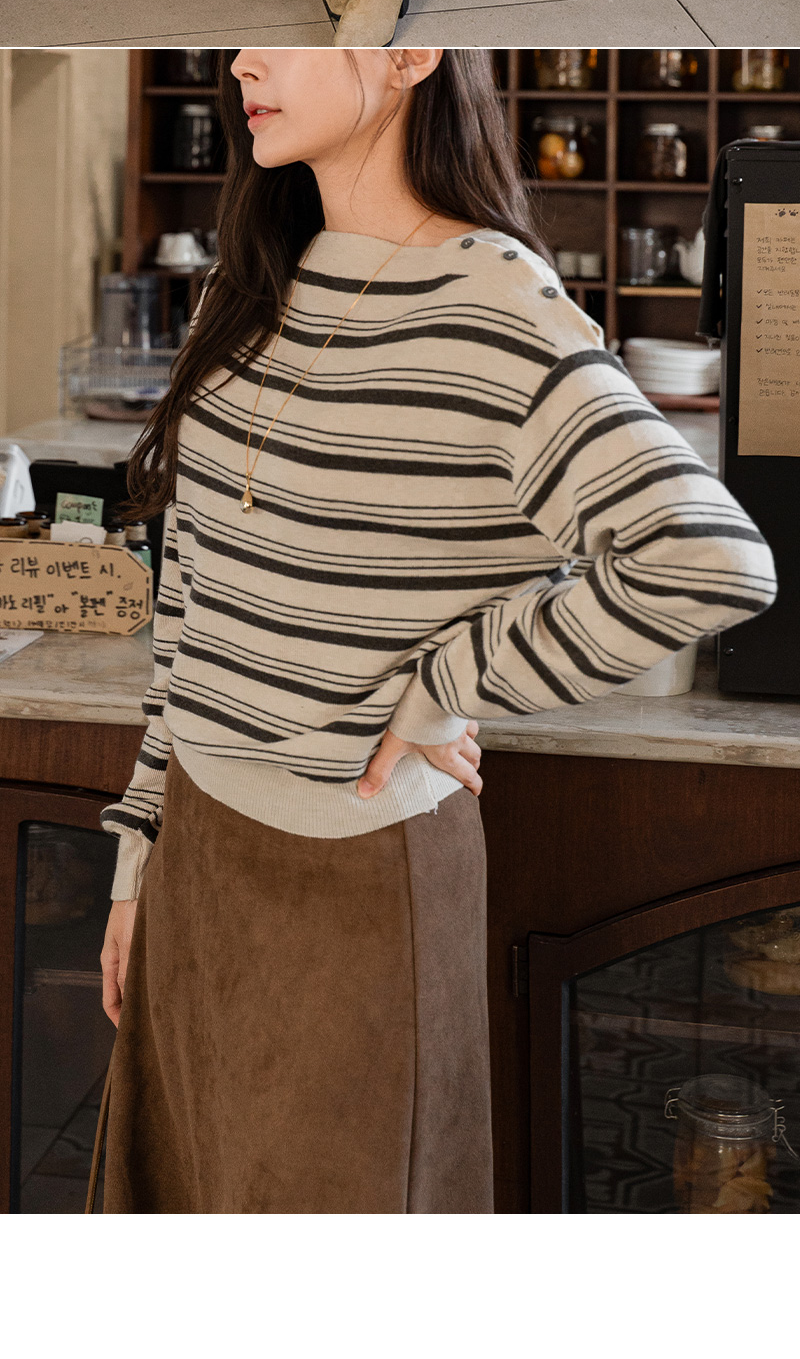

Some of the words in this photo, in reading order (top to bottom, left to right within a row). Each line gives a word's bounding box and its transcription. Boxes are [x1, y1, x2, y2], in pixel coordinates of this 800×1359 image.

[10, 556, 41, 579] 리뷰
[46, 560, 92, 579] 이벤트
[115, 596, 144, 620] 증정
